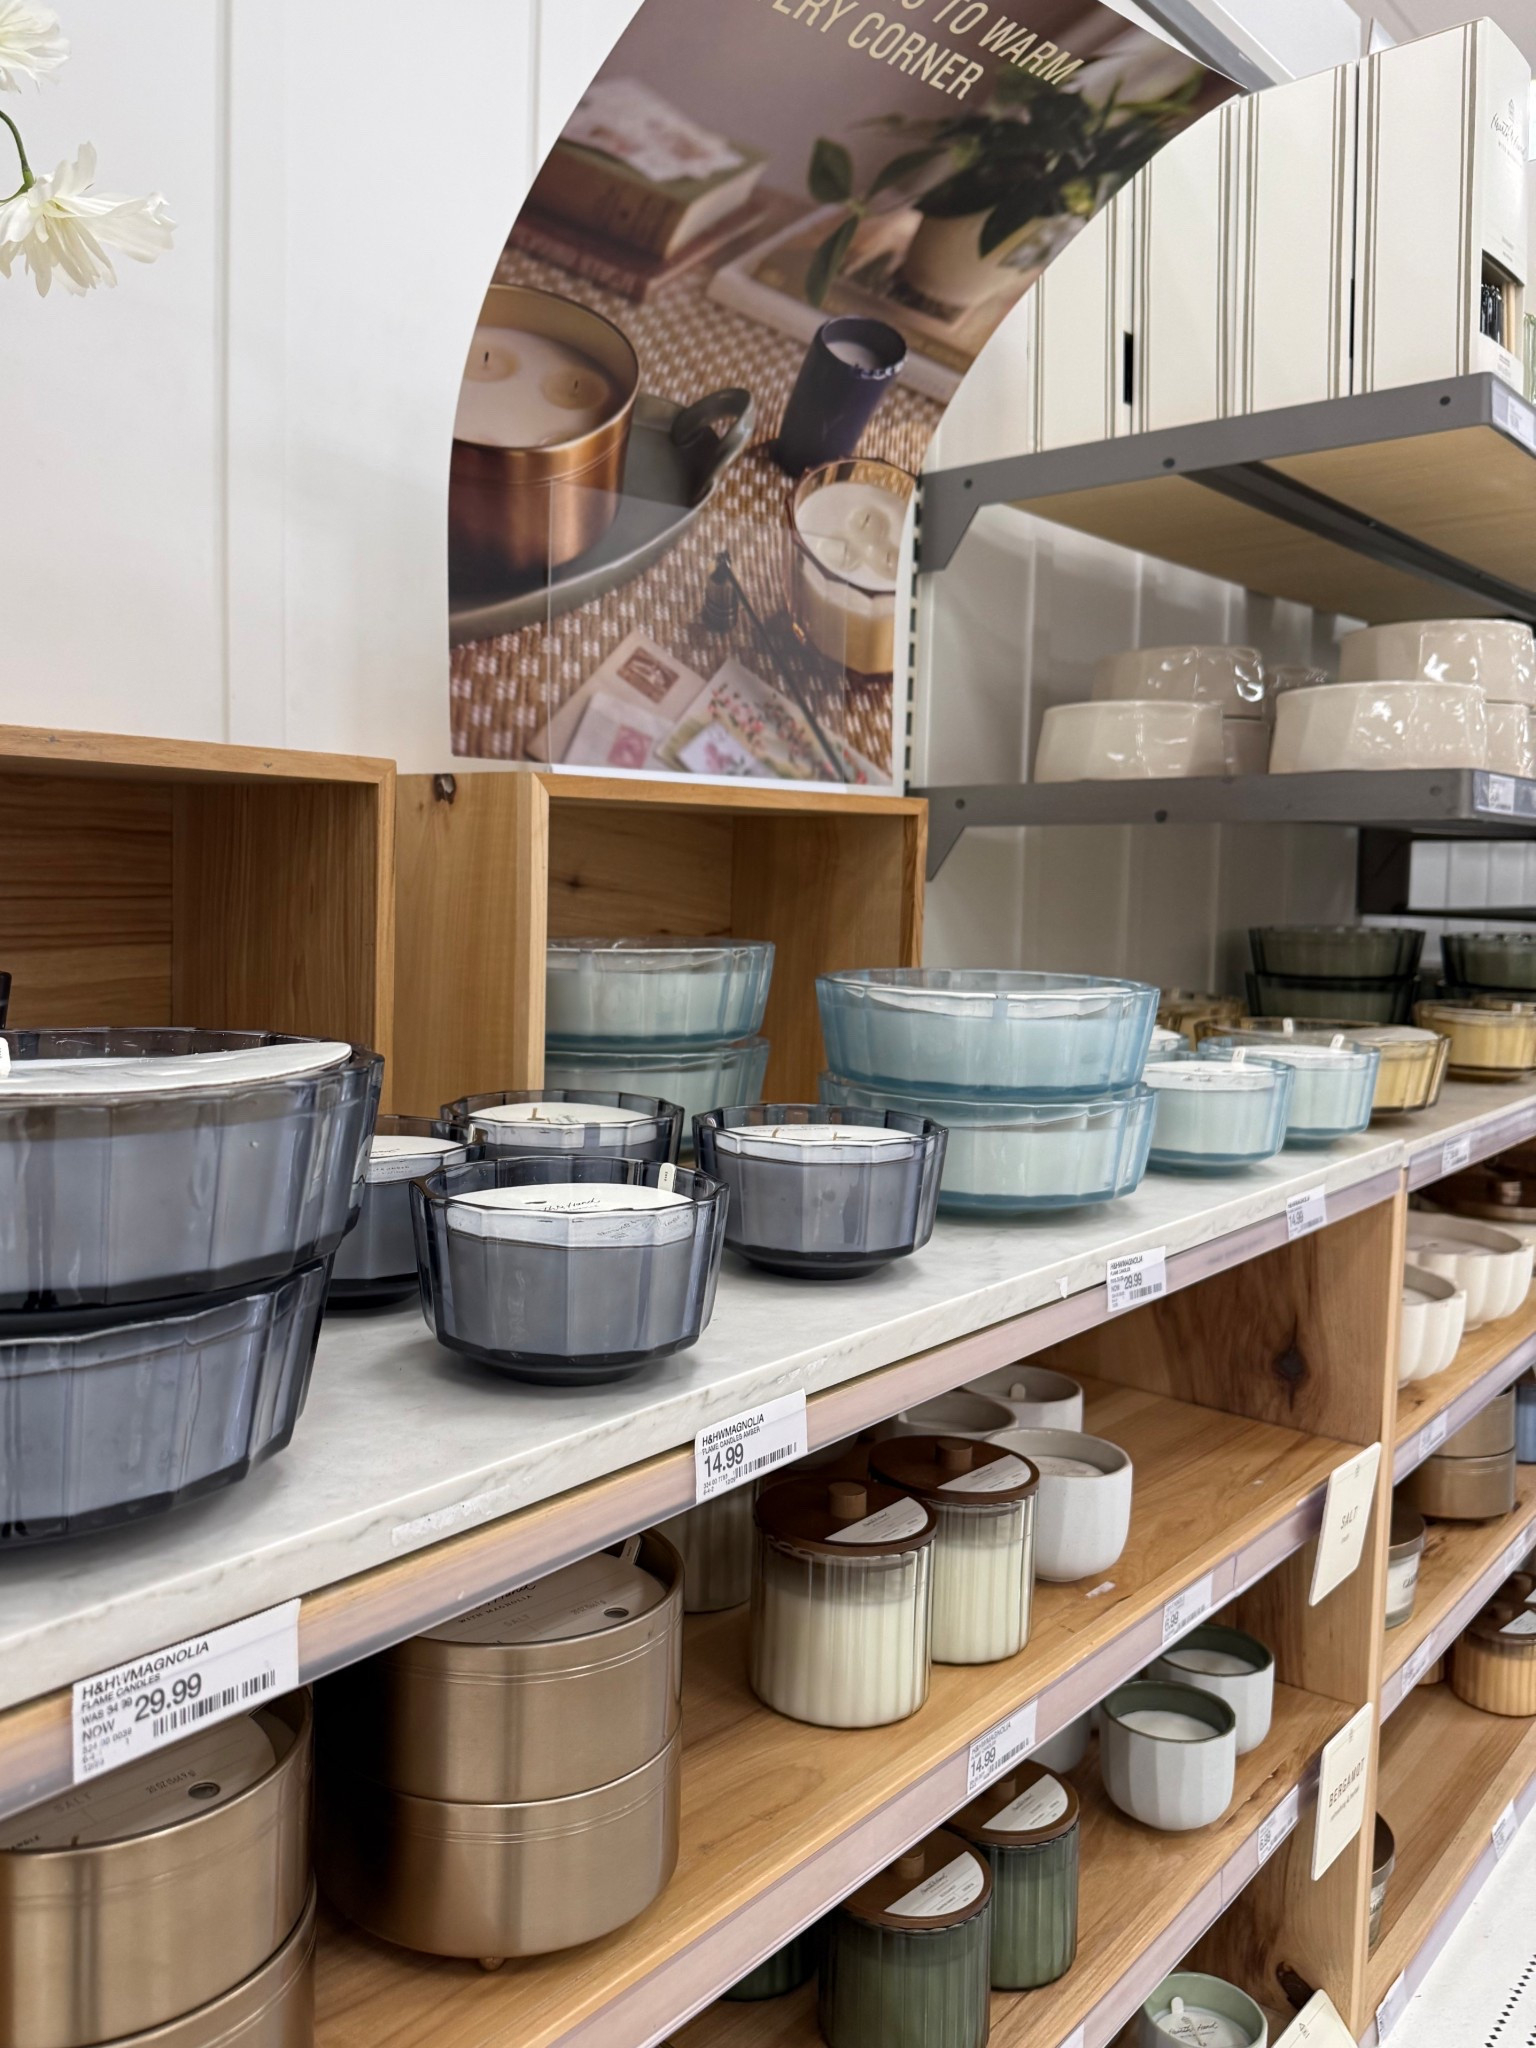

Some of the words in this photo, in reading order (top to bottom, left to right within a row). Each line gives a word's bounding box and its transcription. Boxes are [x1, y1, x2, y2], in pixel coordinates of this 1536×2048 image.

[847, 12, 984, 100] CORNER
[933, 0, 988, 35] TO
[978, 16, 1084, 85] WARM
[1123, 1273, 1142, 1290] 29.99
[702, 1413, 765, 1447] H&HWMAGNOLIA
[702, 1442, 719, 1455] FLAME
[743, 1426, 761, 1439] AMBER
[704, 1442, 744, 1478] 14.99
[82, 1641, 209, 1700] H&HWMAGNOLIA
[82, 1691, 114, 1712] FLAME
[116, 1673, 161, 1697] CANDLES
[82, 1718, 115, 1743] NOW
[134, 1672, 202, 1722] 29.99
[82, 1709, 104, 1727] WAS
[971, 1747, 996, 1777] 14.99
[1329, 1757, 1365, 1808] BERGAMOT
